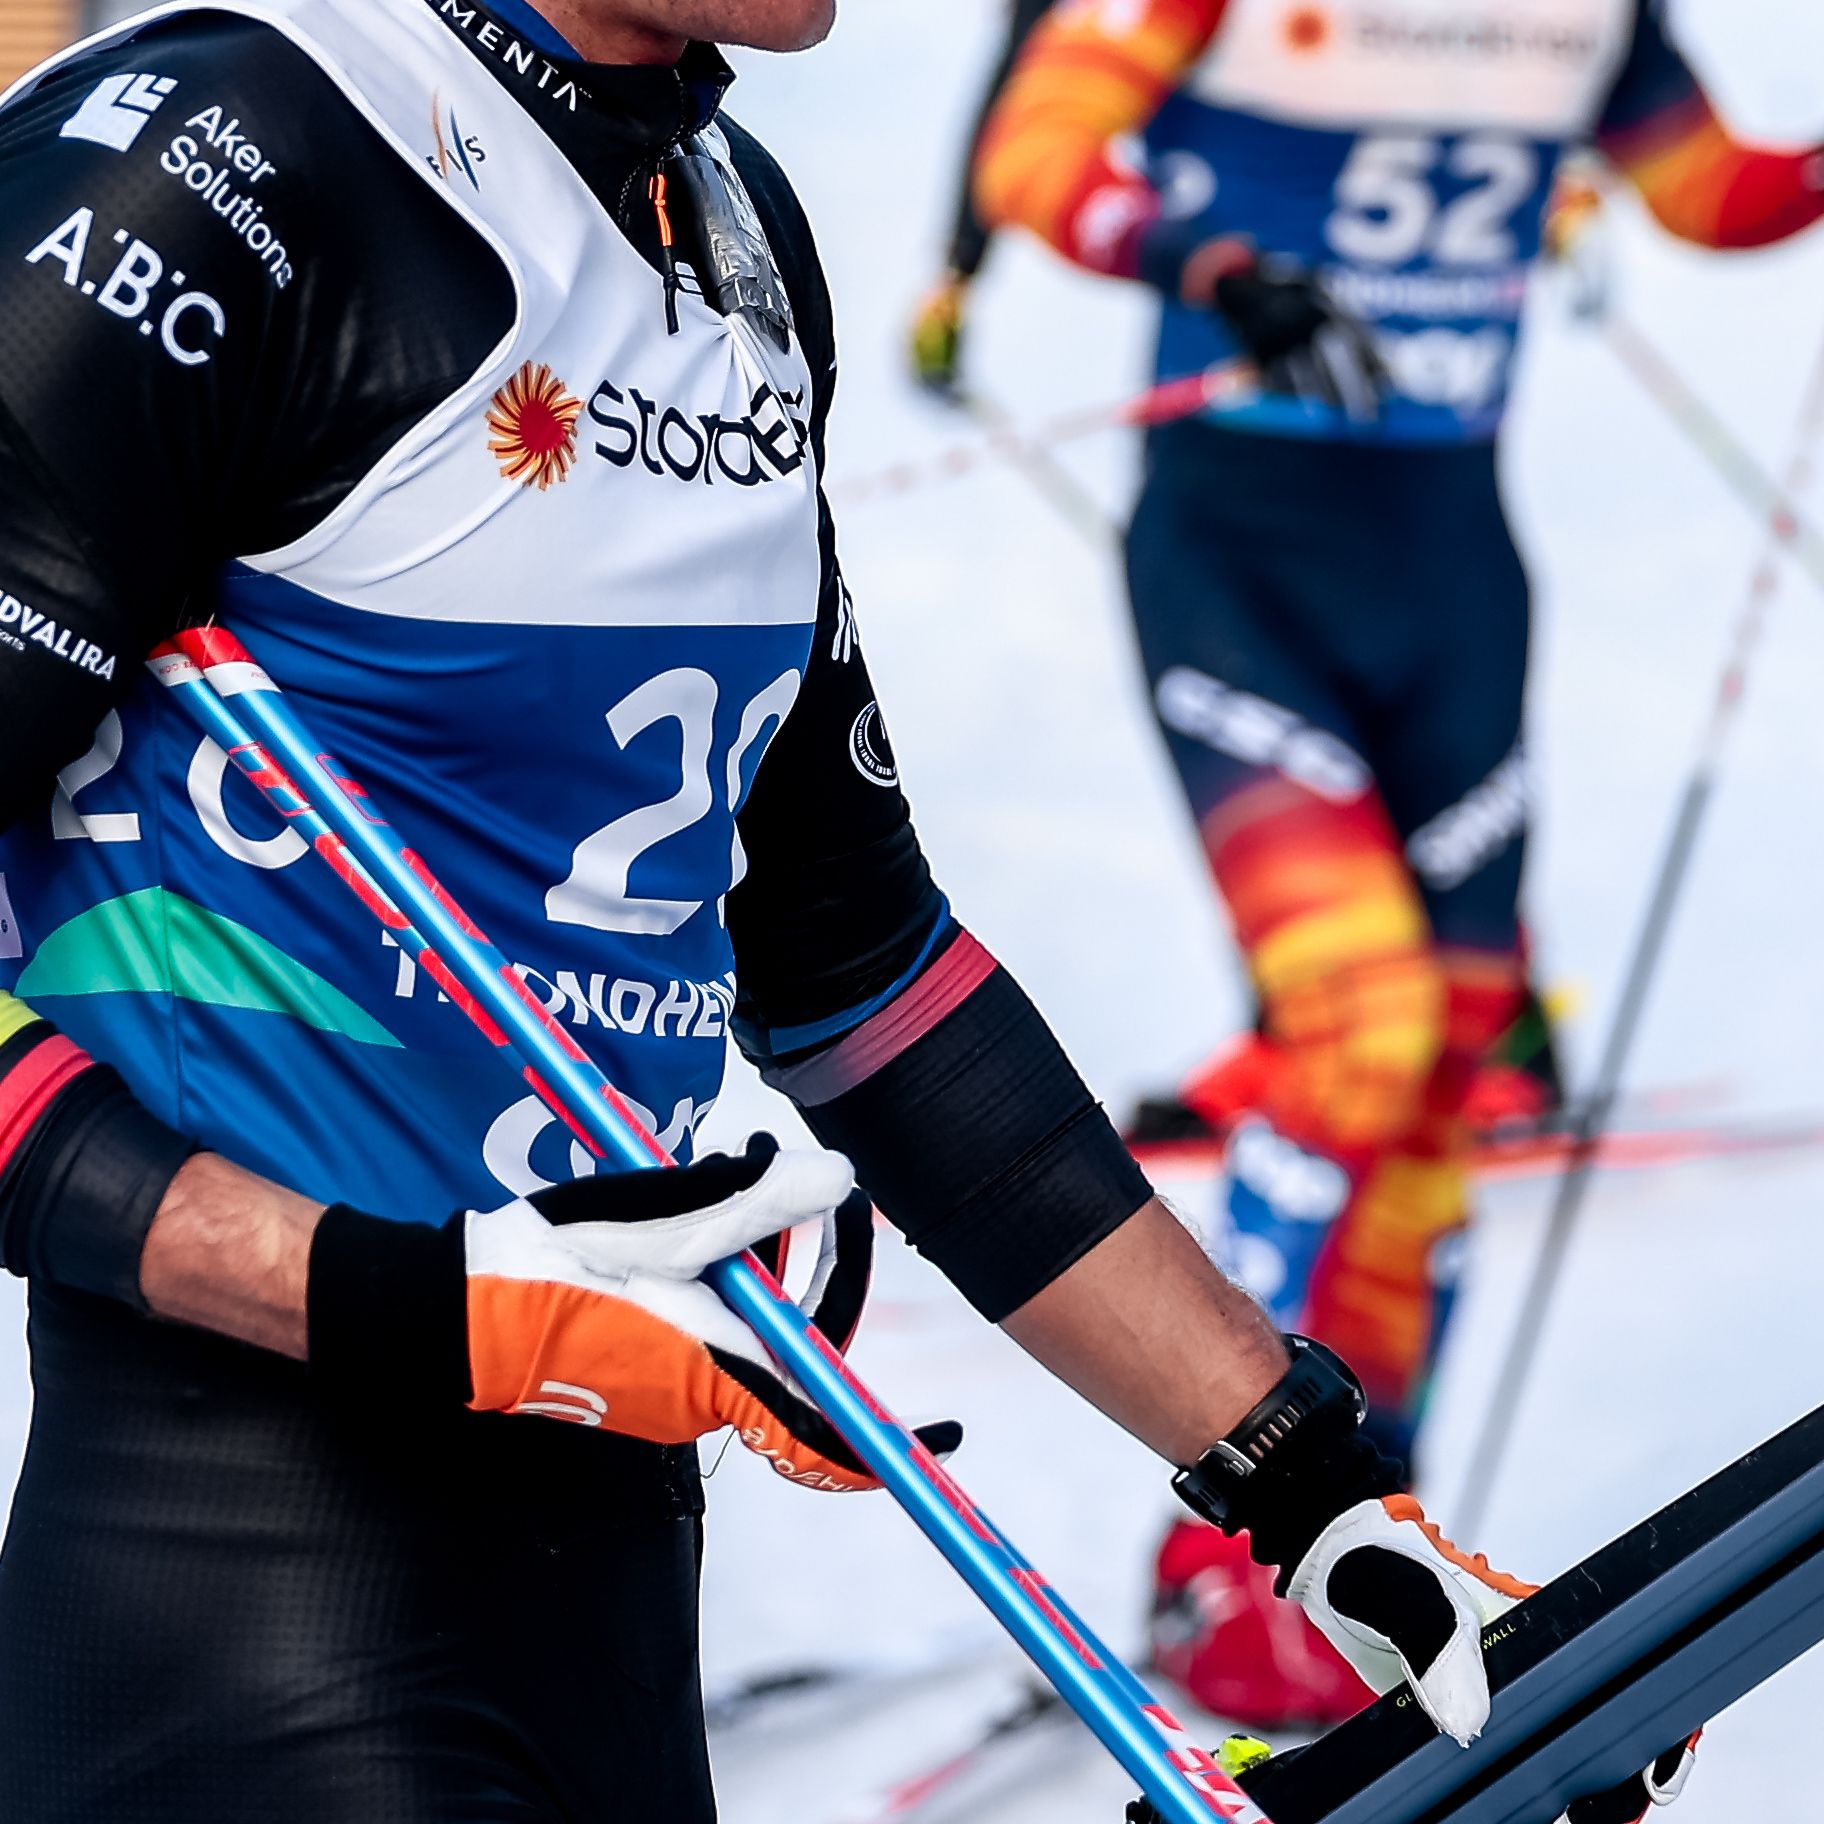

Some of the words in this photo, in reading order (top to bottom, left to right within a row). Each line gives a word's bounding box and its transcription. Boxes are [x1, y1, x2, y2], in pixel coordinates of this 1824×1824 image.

[184, 103, 278, 181] Aker
[1326, 134, 1540, 266] 52
[159, 133, 296, 291] Solutions
